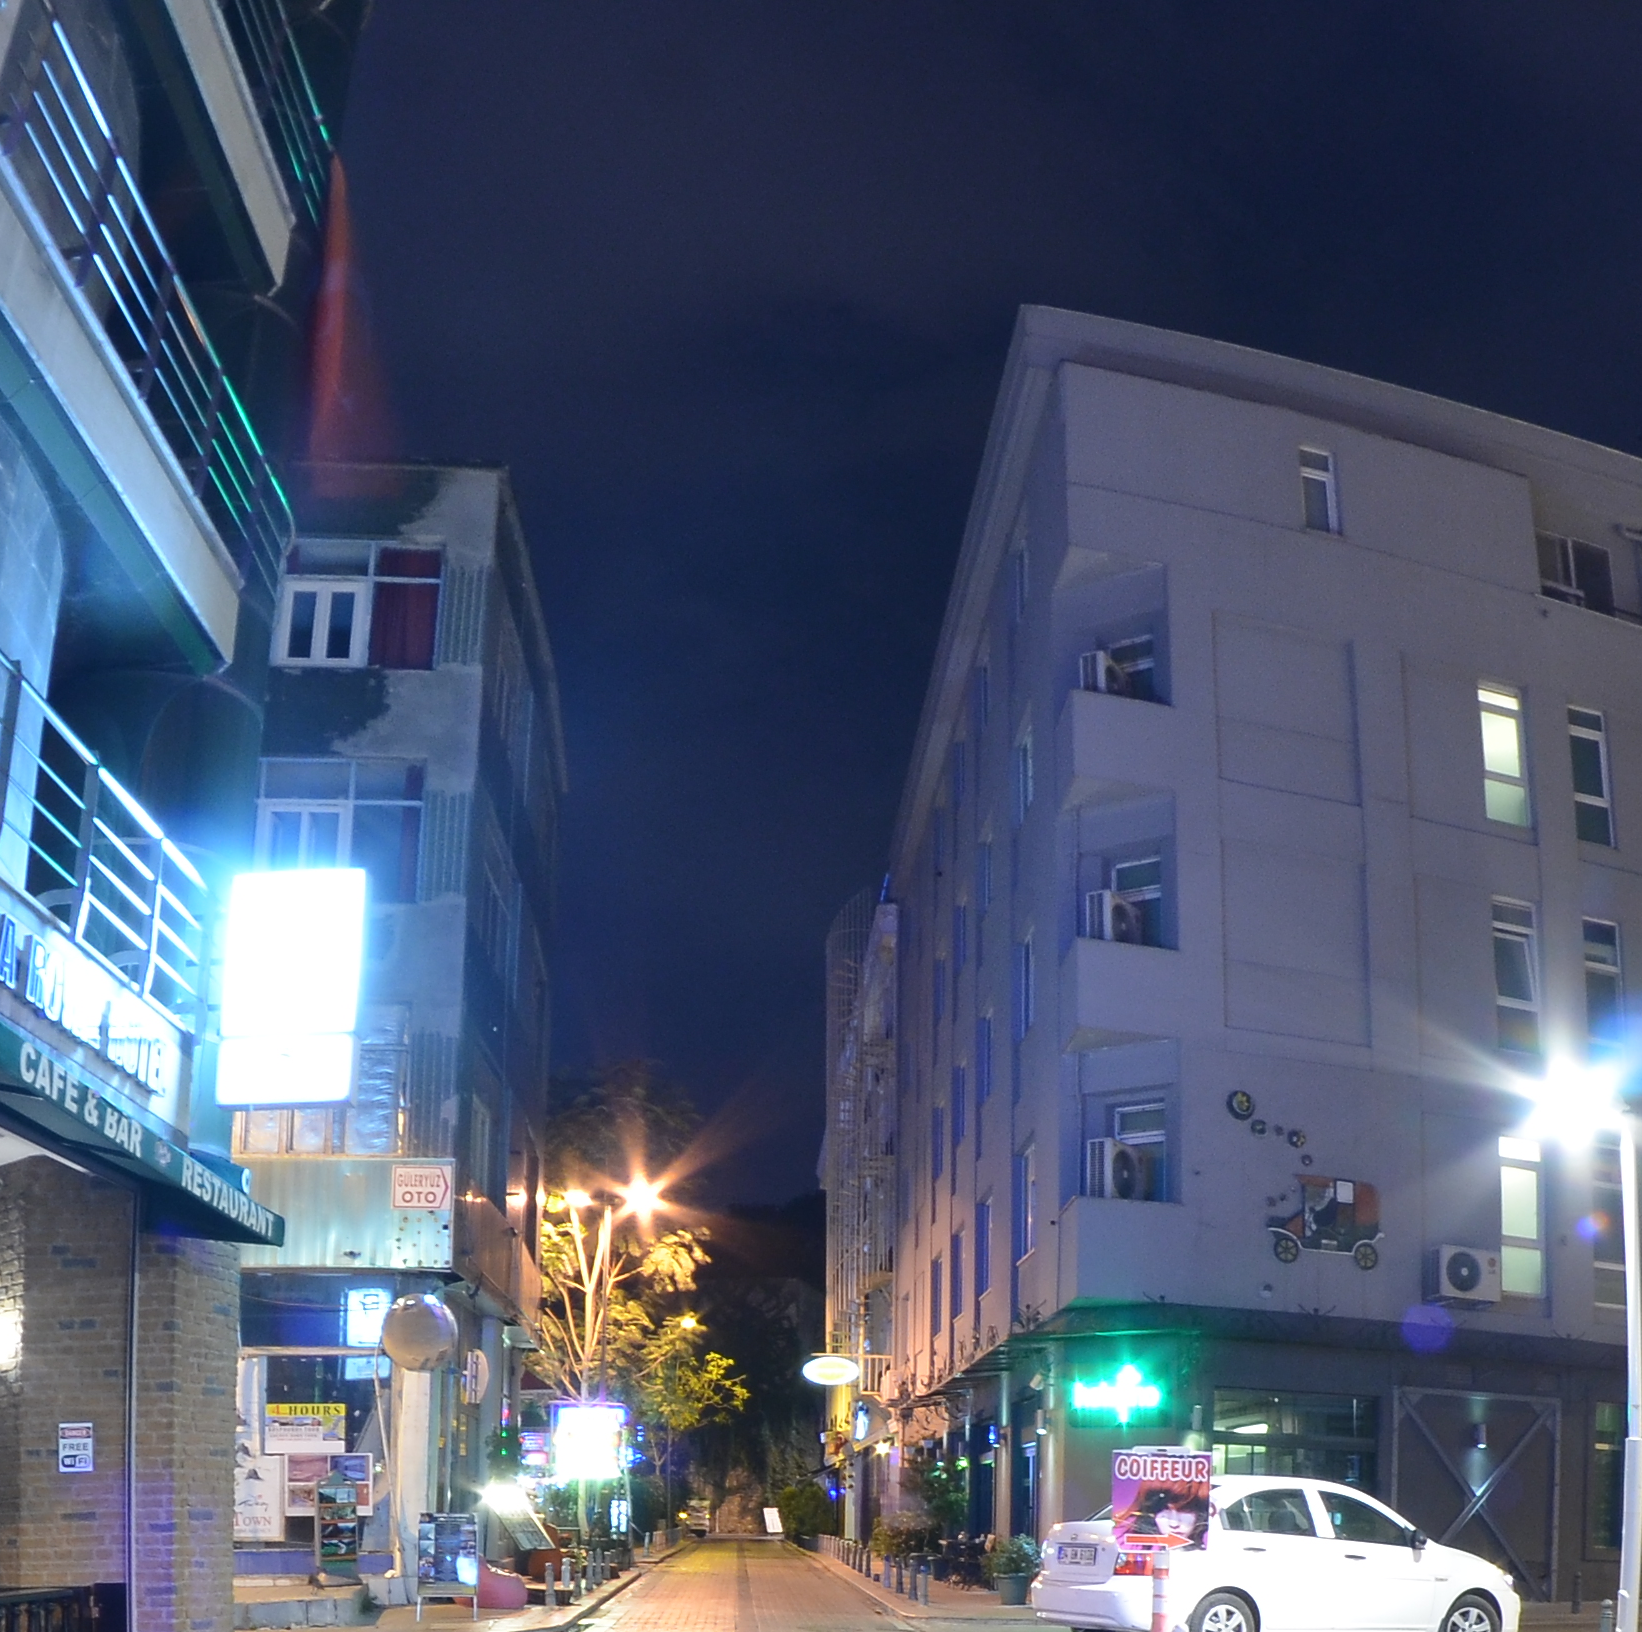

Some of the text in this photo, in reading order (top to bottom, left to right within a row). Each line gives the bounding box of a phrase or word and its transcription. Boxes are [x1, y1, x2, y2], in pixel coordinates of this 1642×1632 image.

[19, 1041, 81, 1114] CAFE
[83, 1087, 101, 1128] &
[103, 1104, 144, 1159] BAR
[181, 1156, 275, 1238] RESTAURANT
[401, 1190, 437, 1204] OTO
[288, 1405, 342, 1416] HOURS
[62, 1442, 89, 1451] FREE
[1116, 1456, 1209, 1481] COIFFEUR
